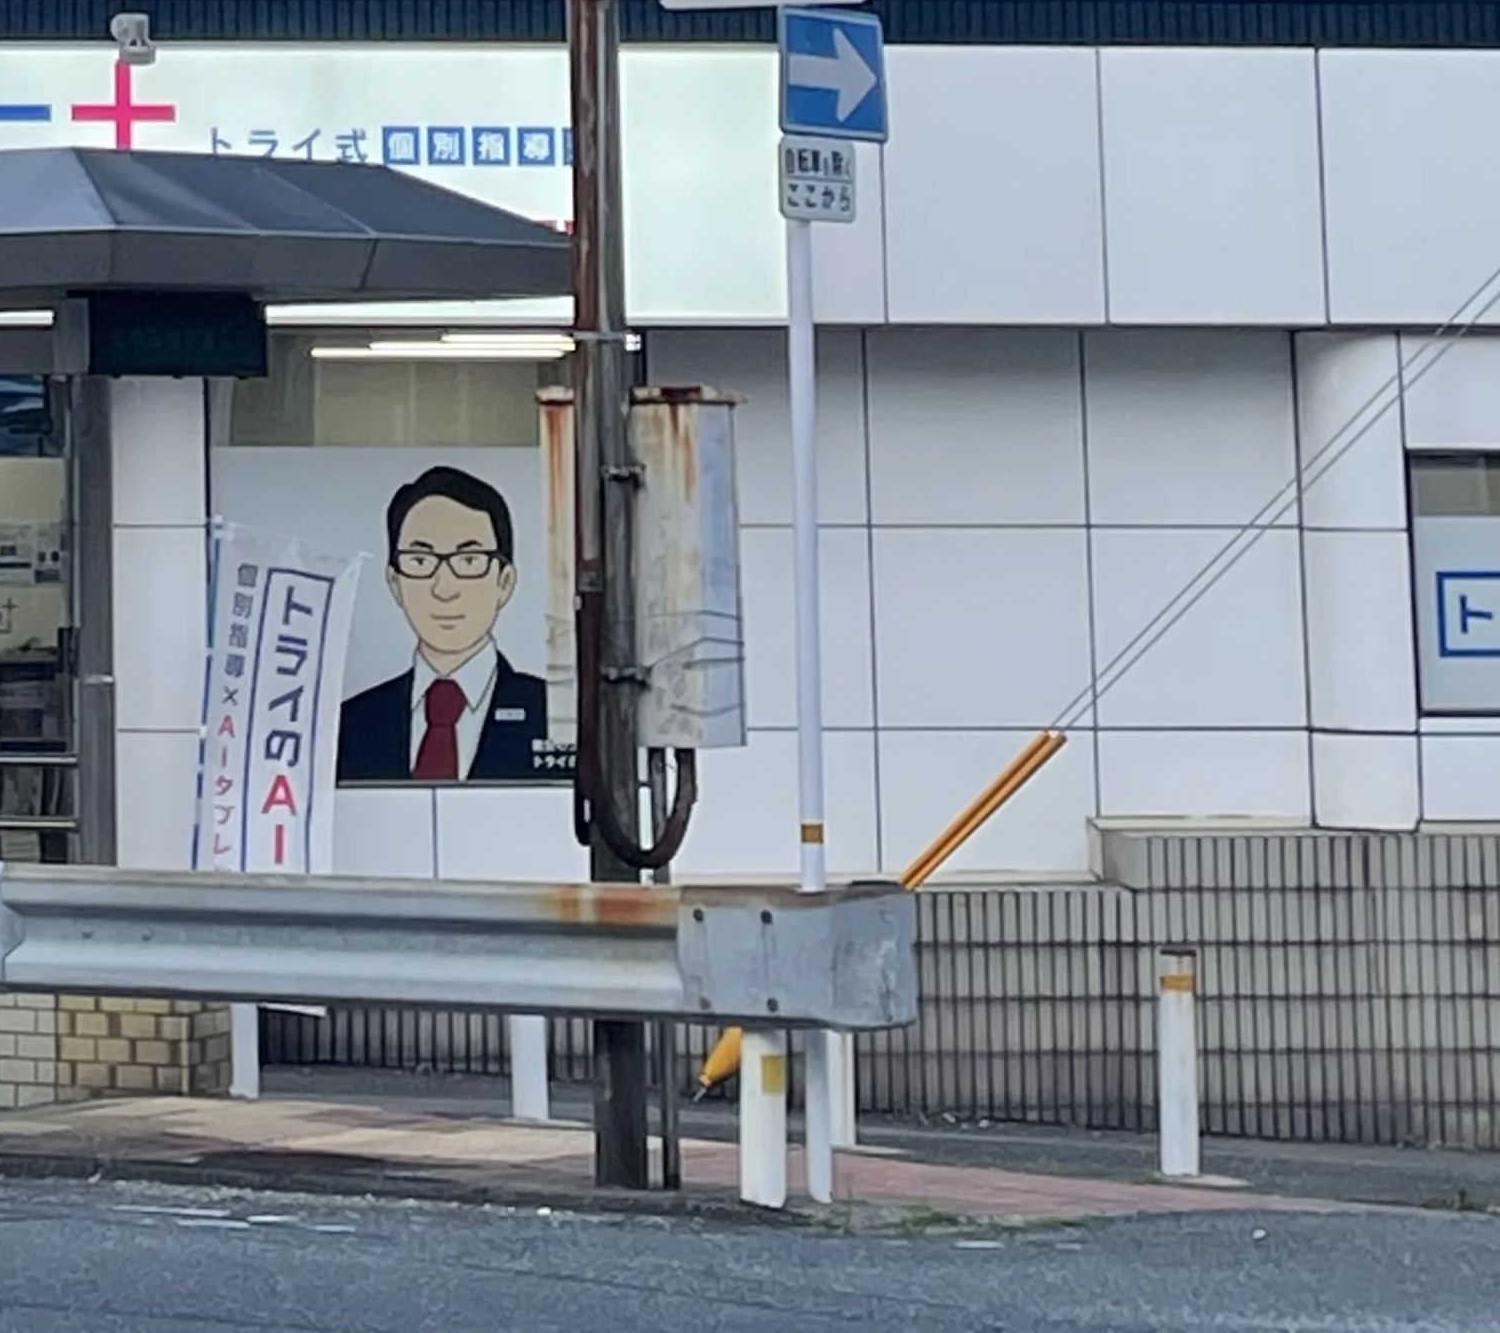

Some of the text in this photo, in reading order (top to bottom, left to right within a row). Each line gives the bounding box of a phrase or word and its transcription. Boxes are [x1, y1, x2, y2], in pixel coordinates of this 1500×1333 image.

[787, 184, 851, 212] ここから
[213, 563, 258, 871] 個別指導×AIタブレ
[261, 585, 314, 865] トライのAI
